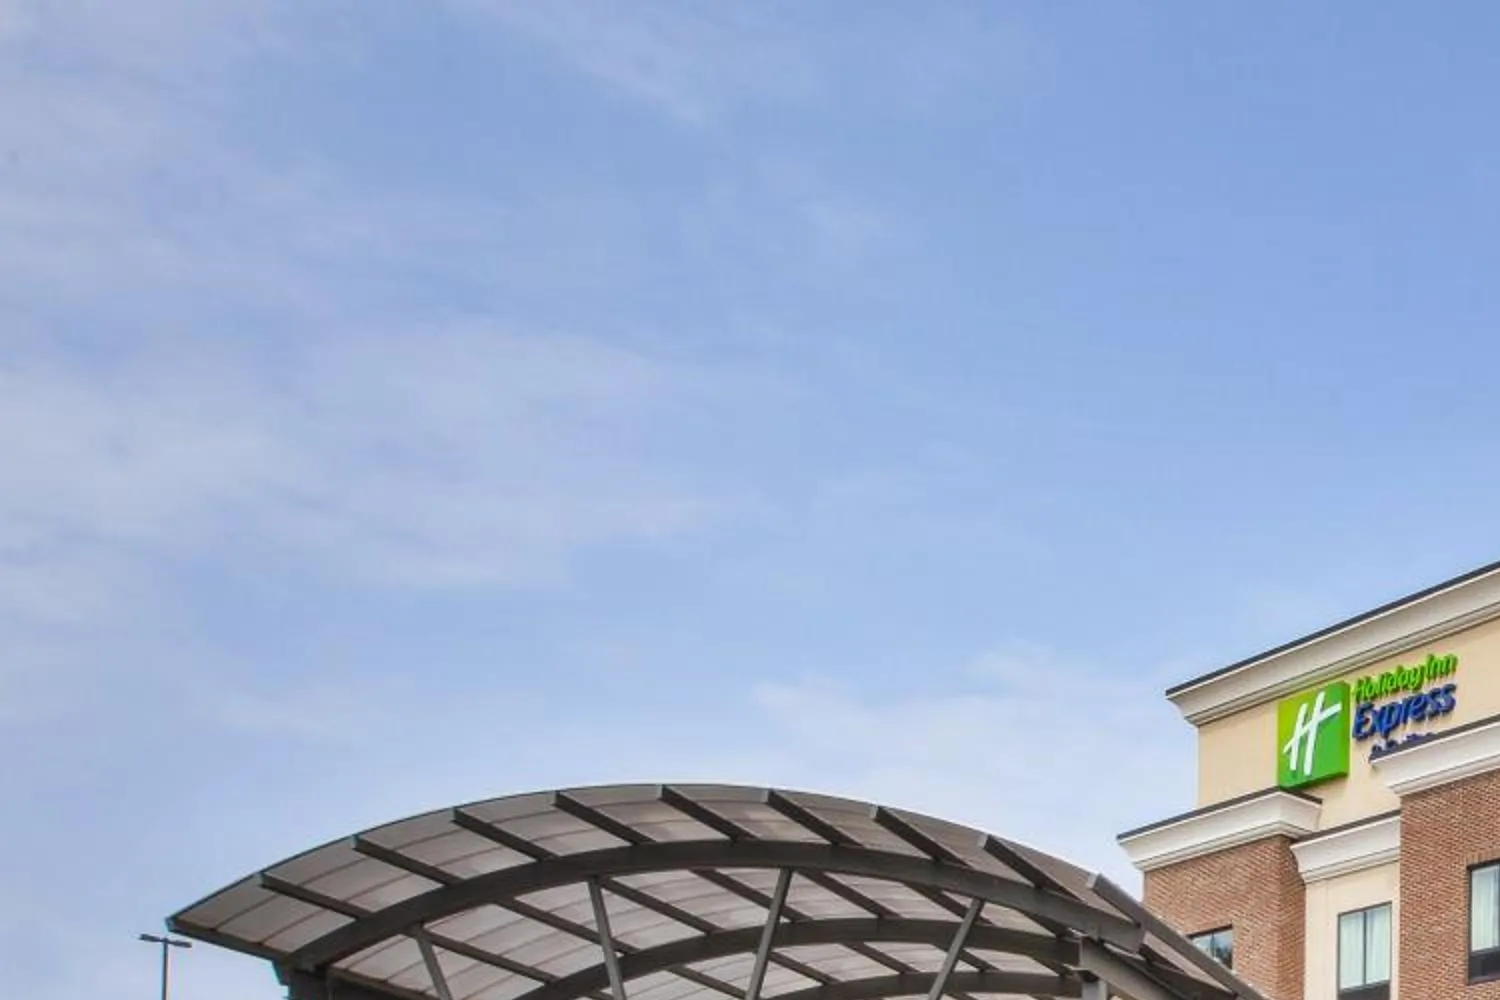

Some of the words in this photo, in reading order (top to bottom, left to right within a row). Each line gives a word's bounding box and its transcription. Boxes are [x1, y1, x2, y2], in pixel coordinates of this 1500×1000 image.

[1355, 664, 1425, 702] Holiday
[1425, 653, 1458, 681] Inn
[1353, 683, 1457, 741] Express
